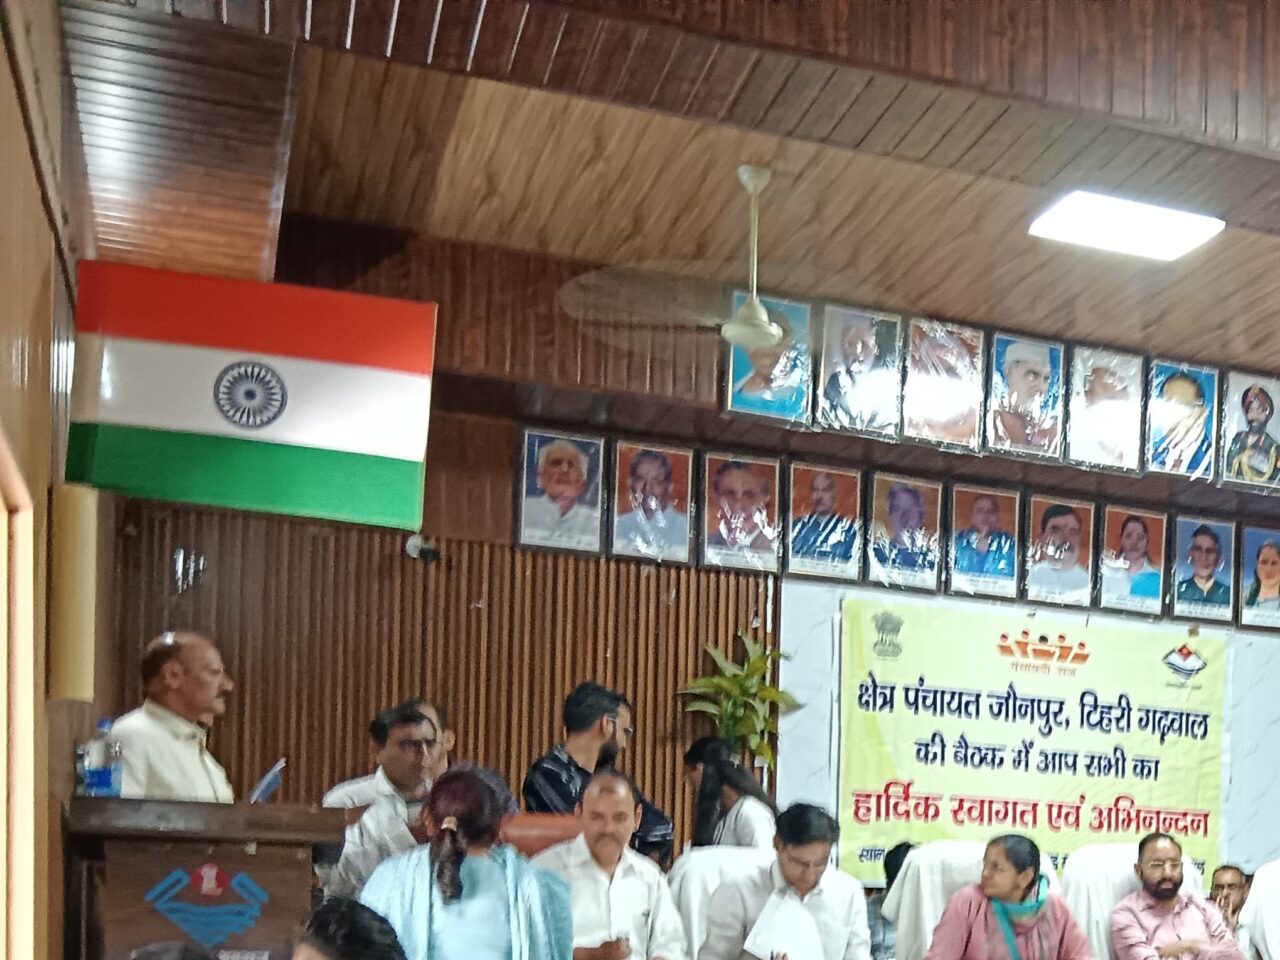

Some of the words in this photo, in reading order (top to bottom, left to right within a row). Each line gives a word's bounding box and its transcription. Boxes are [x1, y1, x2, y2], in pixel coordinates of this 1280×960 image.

[857, 671, 896, 713] क्षेत्र
[903, 675, 982, 720] पंचायत
[986, 681, 1070, 738] जौनपुर,
[1079, 689, 1133, 733] टिहरी
[1137, 704, 1211, 745] गढ़वाल
[914, 730, 946, 767] की
[953, 731, 1007, 770] बैठक
[1012, 739, 1034, 773] में
[1036, 750, 1079, 776] आप
[1083, 744, 1126, 780] सभी
[1132, 754, 1161, 781] का
[852, 779, 942, 825] हार्दिक
[950, 794, 1038, 829] स्वागत
[1047, 793, 1085, 832] एवं
[1088, 792, 1211, 837] अभिनन्दन
